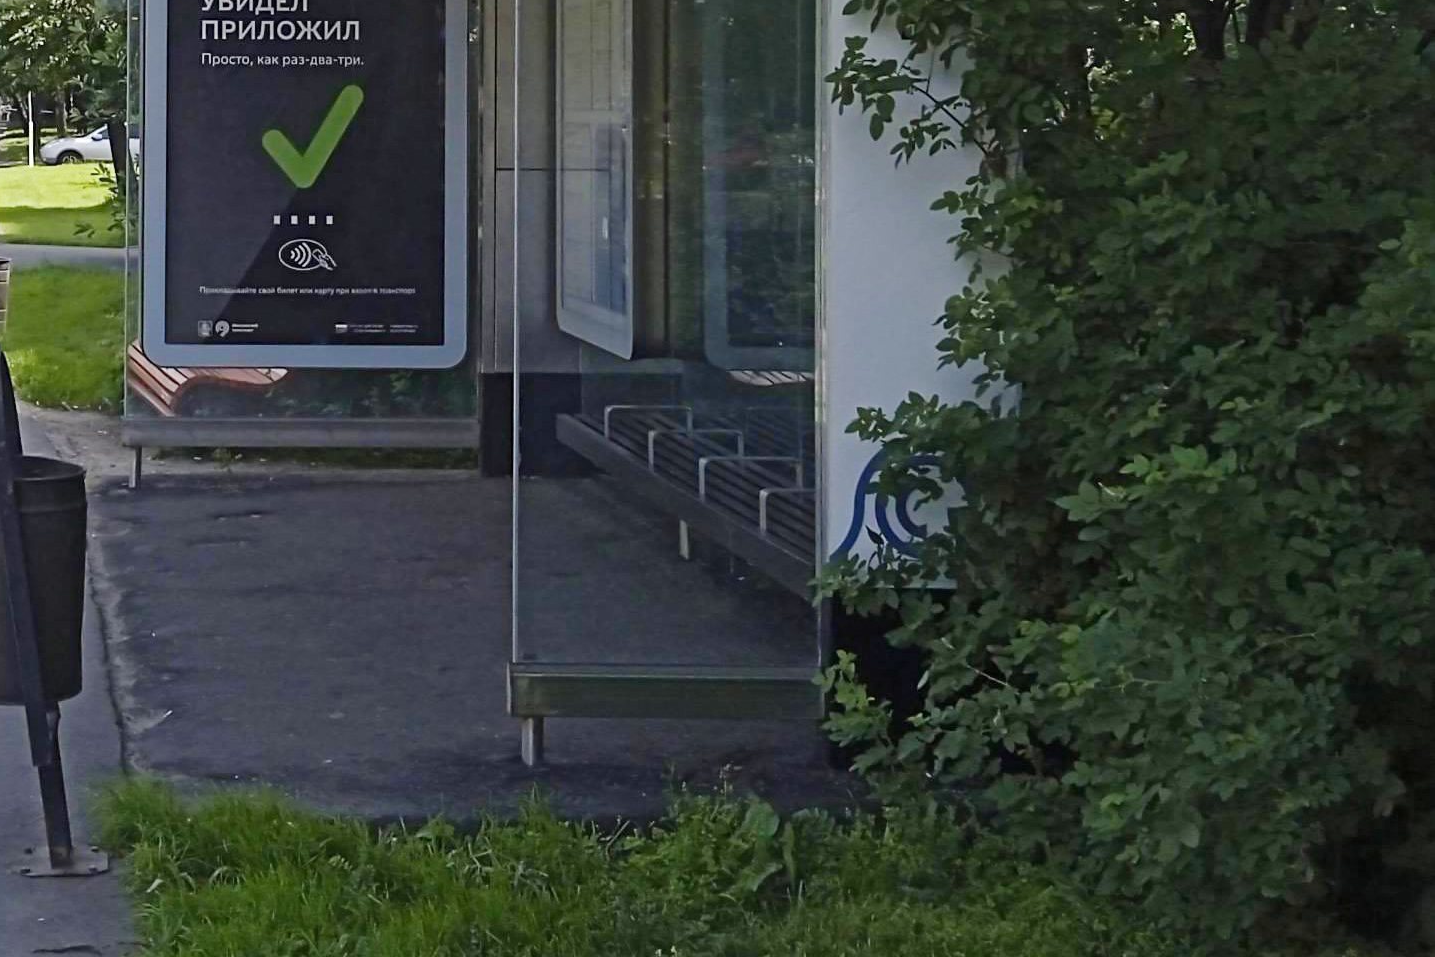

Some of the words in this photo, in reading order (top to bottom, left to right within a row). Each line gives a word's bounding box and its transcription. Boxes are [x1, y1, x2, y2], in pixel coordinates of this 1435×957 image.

[200, 20, 360, 41] ПРИЛОЖИЛ
[201, 52, 254, 67] Просто,
[257, 54, 279, 66] как
[282, 55, 365, 67] раз-два-три.
